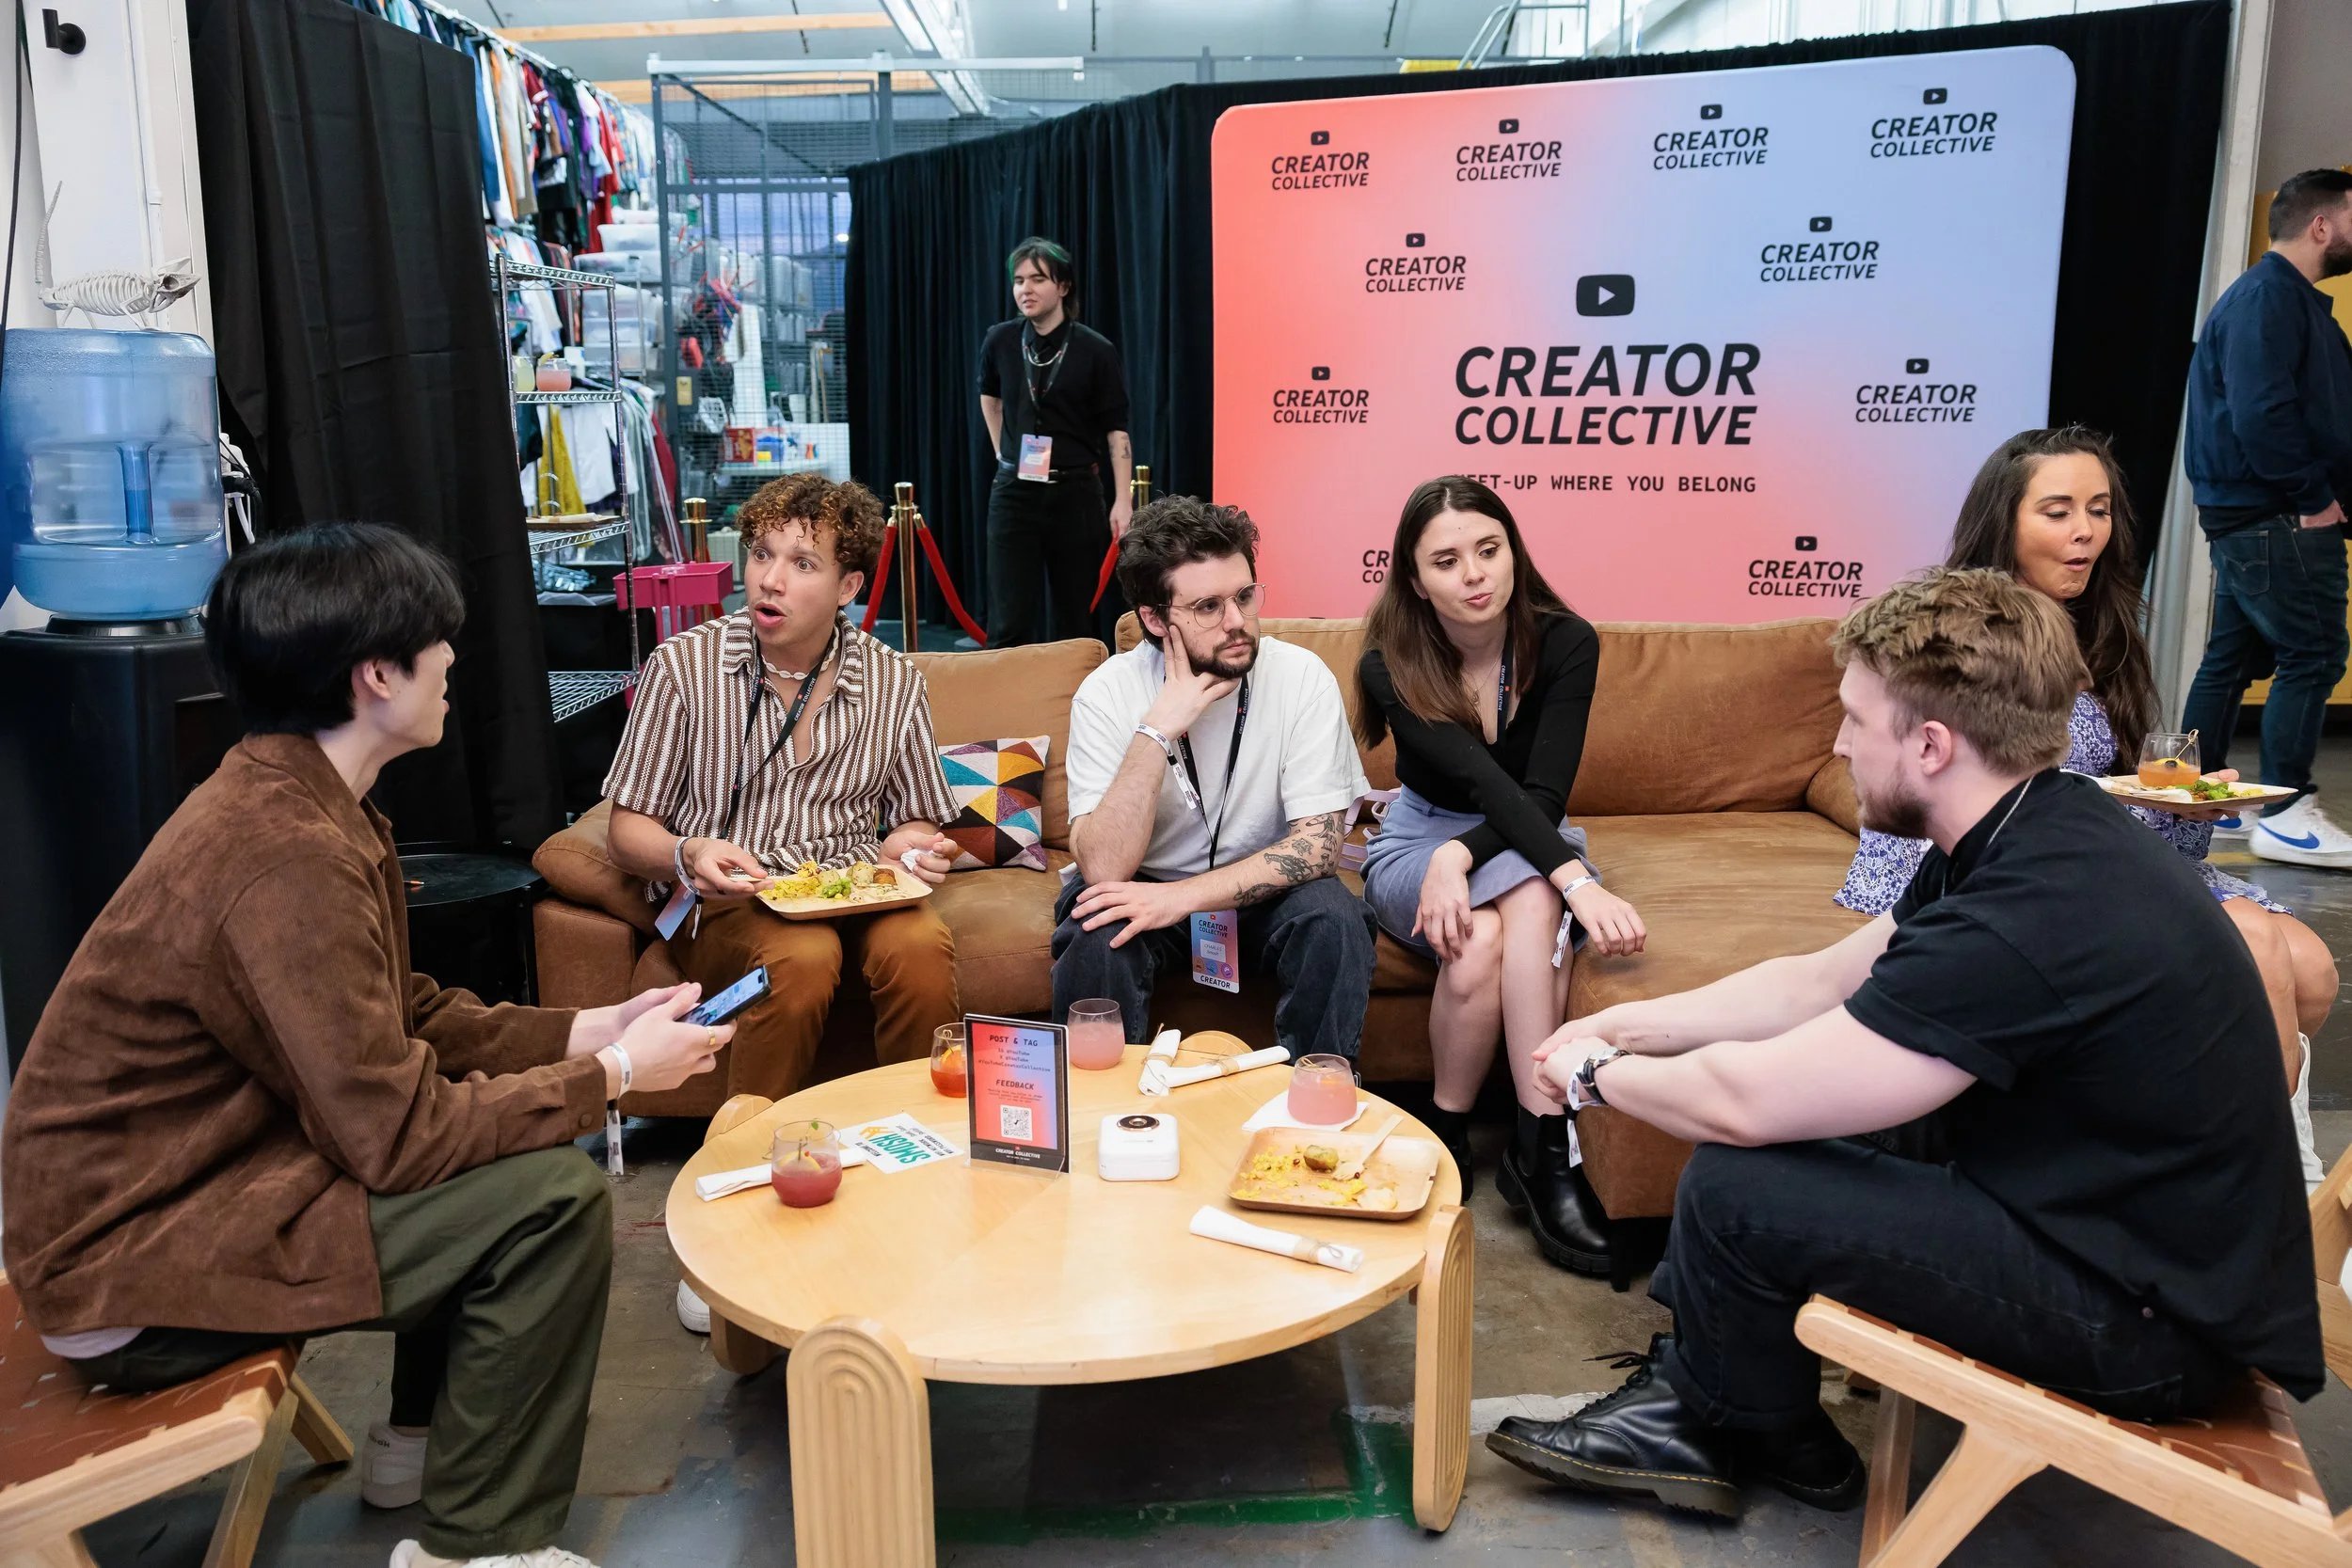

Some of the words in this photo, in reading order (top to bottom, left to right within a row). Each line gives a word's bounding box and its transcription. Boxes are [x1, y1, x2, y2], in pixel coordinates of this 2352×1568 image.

[1870, 111, 1998, 139] CREATOR
[1653, 127, 1769, 153] CREATOR
[1870, 135, 1995, 158] COLLECTIVE
[1271, 151, 1370, 175] CREATOR
[1456, 140, 1563, 166] CREATOR
[1653, 150, 1768, 170] COLLECTIVE
[1272, 173, 1370, 191] COLLECTIVE
[1456, 163, 1562, 182] COLLECTIVE
[1760, 241, 1880, 264] CREATOR
[1365, 255, 1467, 277] CREATOR
[1760, 264, 1878, 282] COLLECTIVE
[1365, 277, 1466, 293] COLLECTIVE
[1454, 343, 1761, 399] CREATOR
[1273, 388, 1370, 408] CREATOR
[1856, 384, 1978, 405] CREATOR
[1273, 409, 1370, 423] COLLECTIVE
[1855, 406, 1976, 423] COLLECTIVE
[1454, 405, 1758, 446] COLLECTIVE
[1454, 474, 1537, 490] ET-UP
[1550, 474, 1613, 491] WHERE
[1627, 475, 1664, 492] YOU
[1677, 476, 1756, 493] BELONG
[1748, 559, 1864, 581] CREATOR
[1748, 580, 1863, 598] COLLECTIVE
[794, 703, 804, 721] CREATOR
[803, 677, 817, 703] COLLECTIVE
[1178, 736, 1188, 760] OLLECTIVE
[1198, 919, 1229, 932] CREATOR
[1199, 926, 1229, 938] COLLECTIVE
[1200, 974, 1231, 990] CREATOR
[989, 1035, 1009, 1044] POST
[1024, 1038, 1039, 1047] TAG
[995, 1079, 1035, 1090] FEEDBACK
[868, 1132, 931, 1164] SMOSH
[1015, 1150, 1041, 1159] COLLECTIVE
